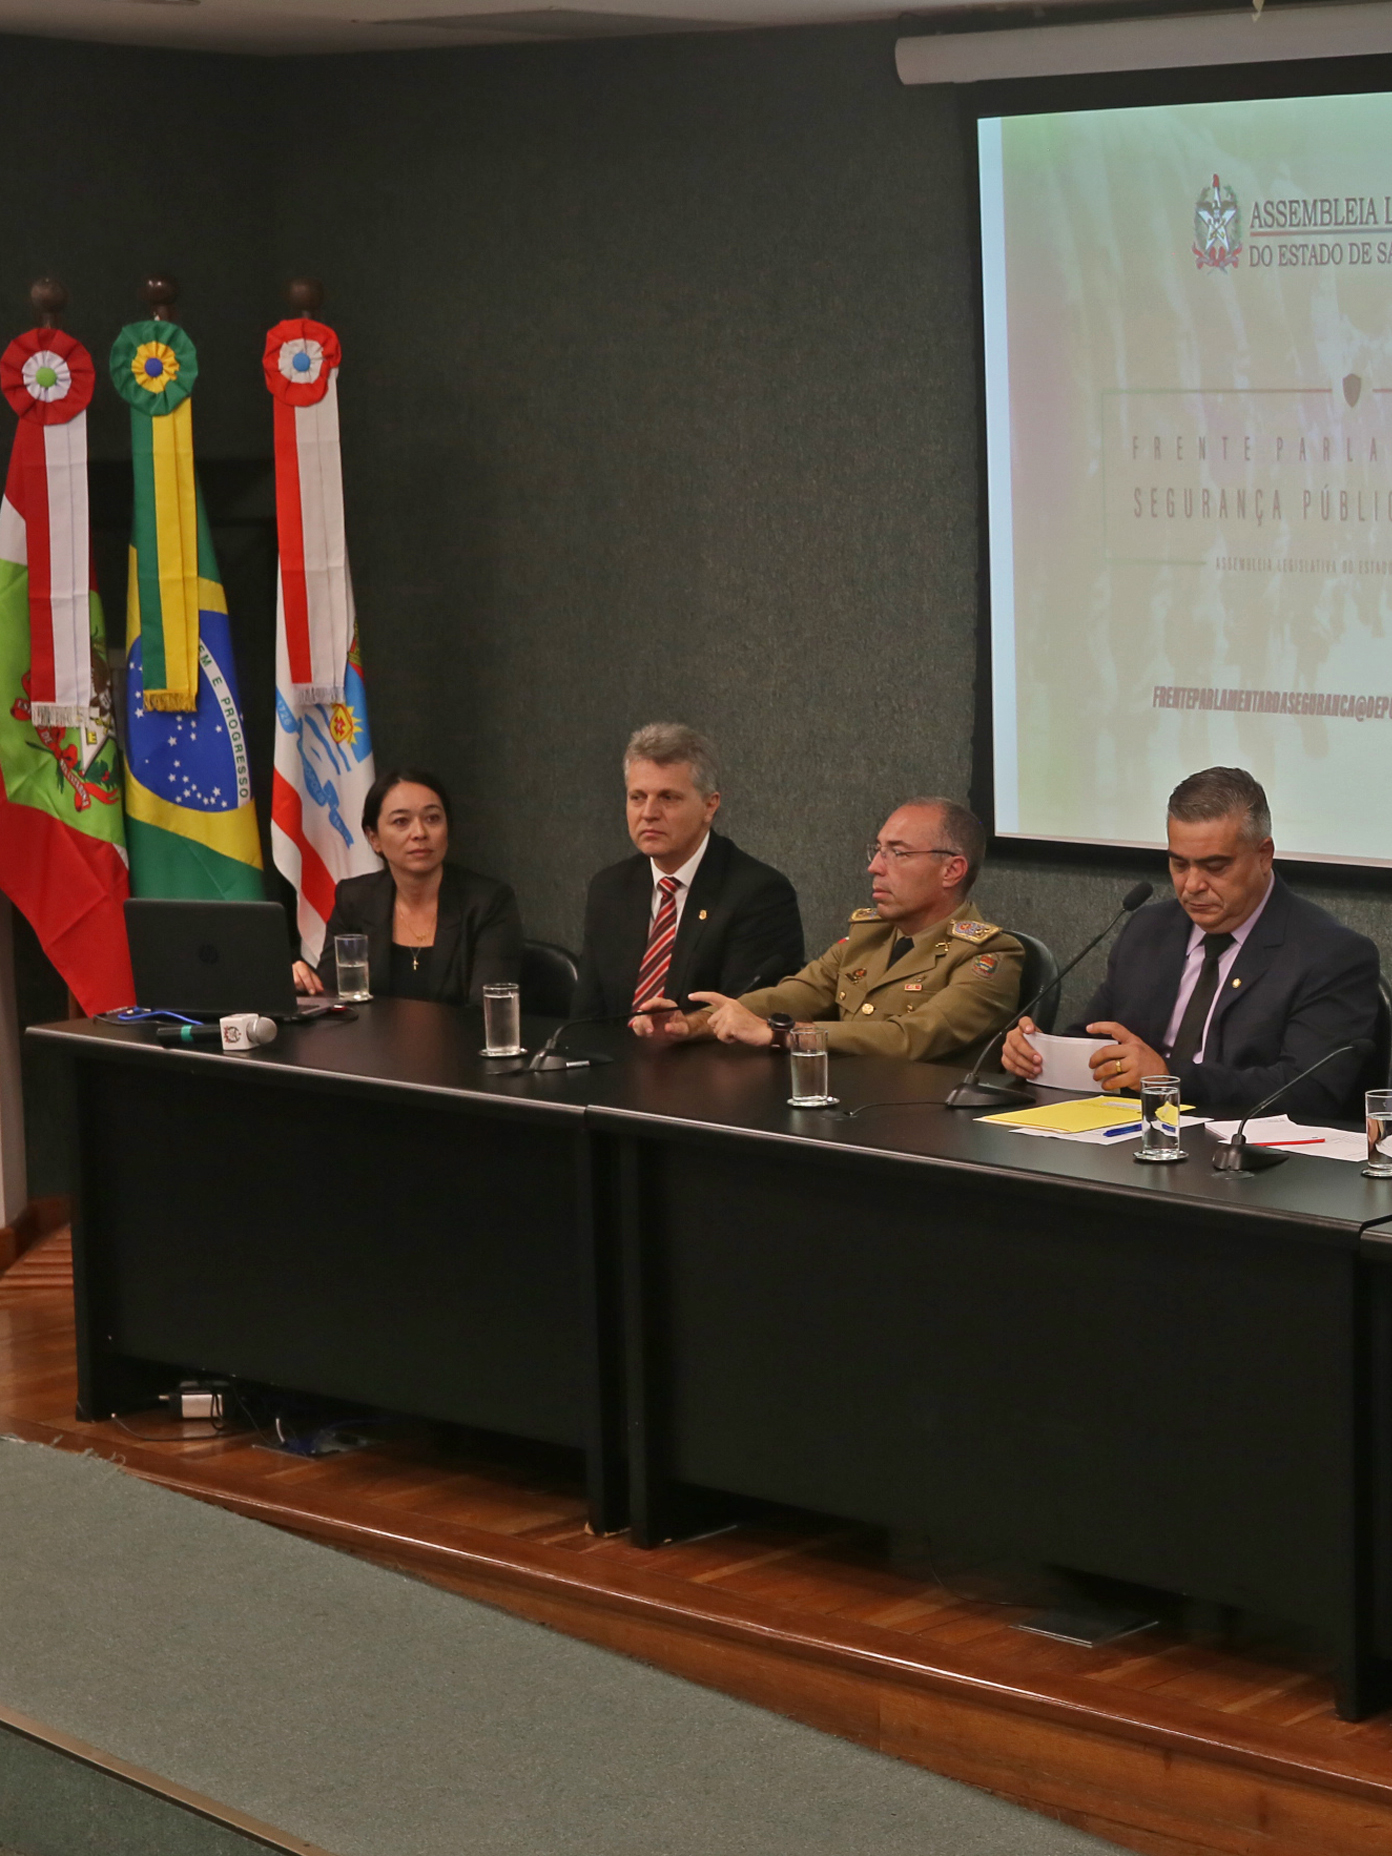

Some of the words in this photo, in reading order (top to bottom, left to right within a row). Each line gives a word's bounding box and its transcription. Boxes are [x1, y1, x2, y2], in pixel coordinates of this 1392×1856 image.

[1250, 197, 1377, 229] ASSEMBLEIA
[1249, 245, 1272, 267] DO
[1278, 243, 1343, 266] ESTADO
[1348, 242, 1372, 264] DE
[1132, 435, 1251, 461] FRENTE
[1133, 487, 1282, 527] SEGURANÇA
[220, 697, 249, 798] PROGRESSO
